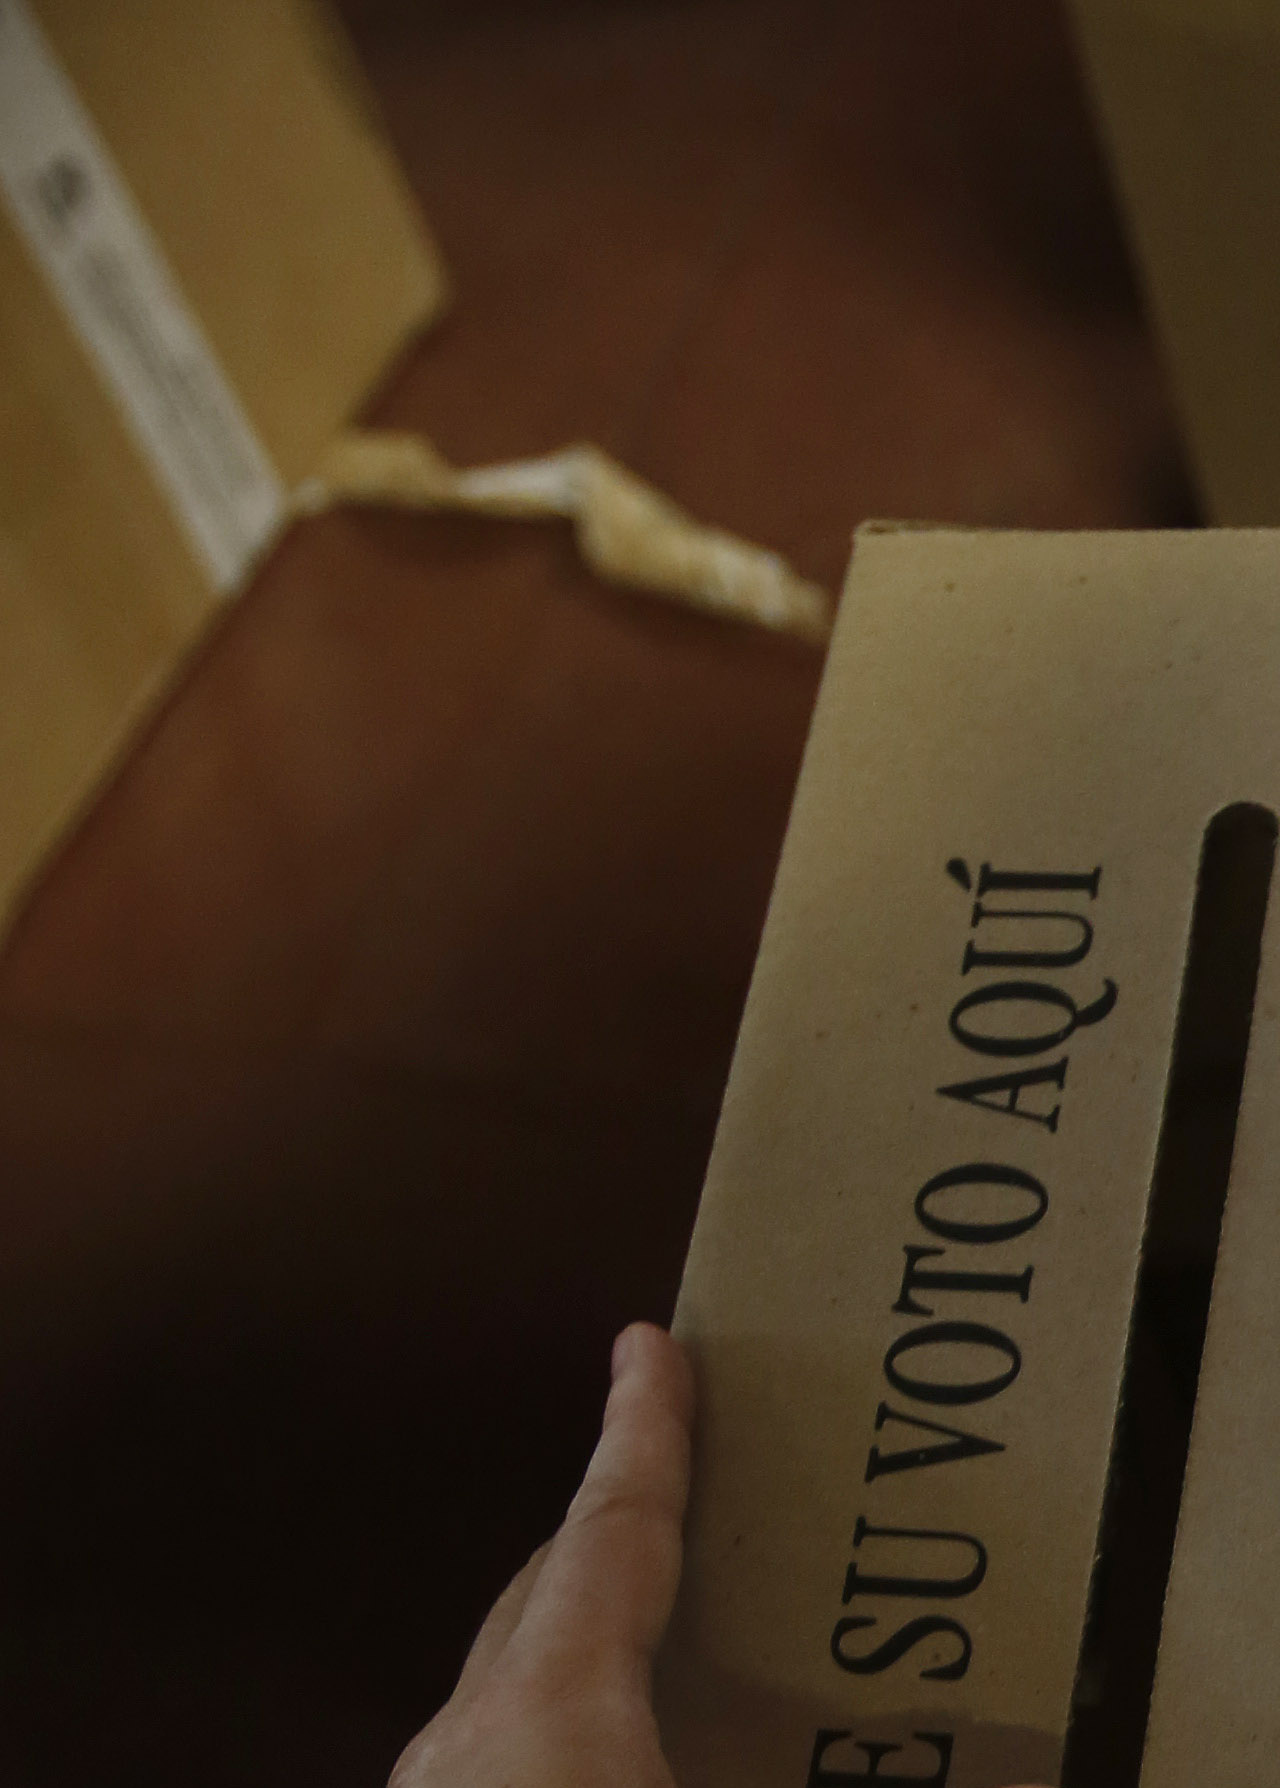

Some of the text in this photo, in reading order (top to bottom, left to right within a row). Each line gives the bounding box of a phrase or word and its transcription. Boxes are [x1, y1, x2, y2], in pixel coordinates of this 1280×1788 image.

[935, 857, 1118, 1134] AQUÍ
[865, 1162, 1049, 1483] VOTO
[831, 1516, 988, 1682] SU
